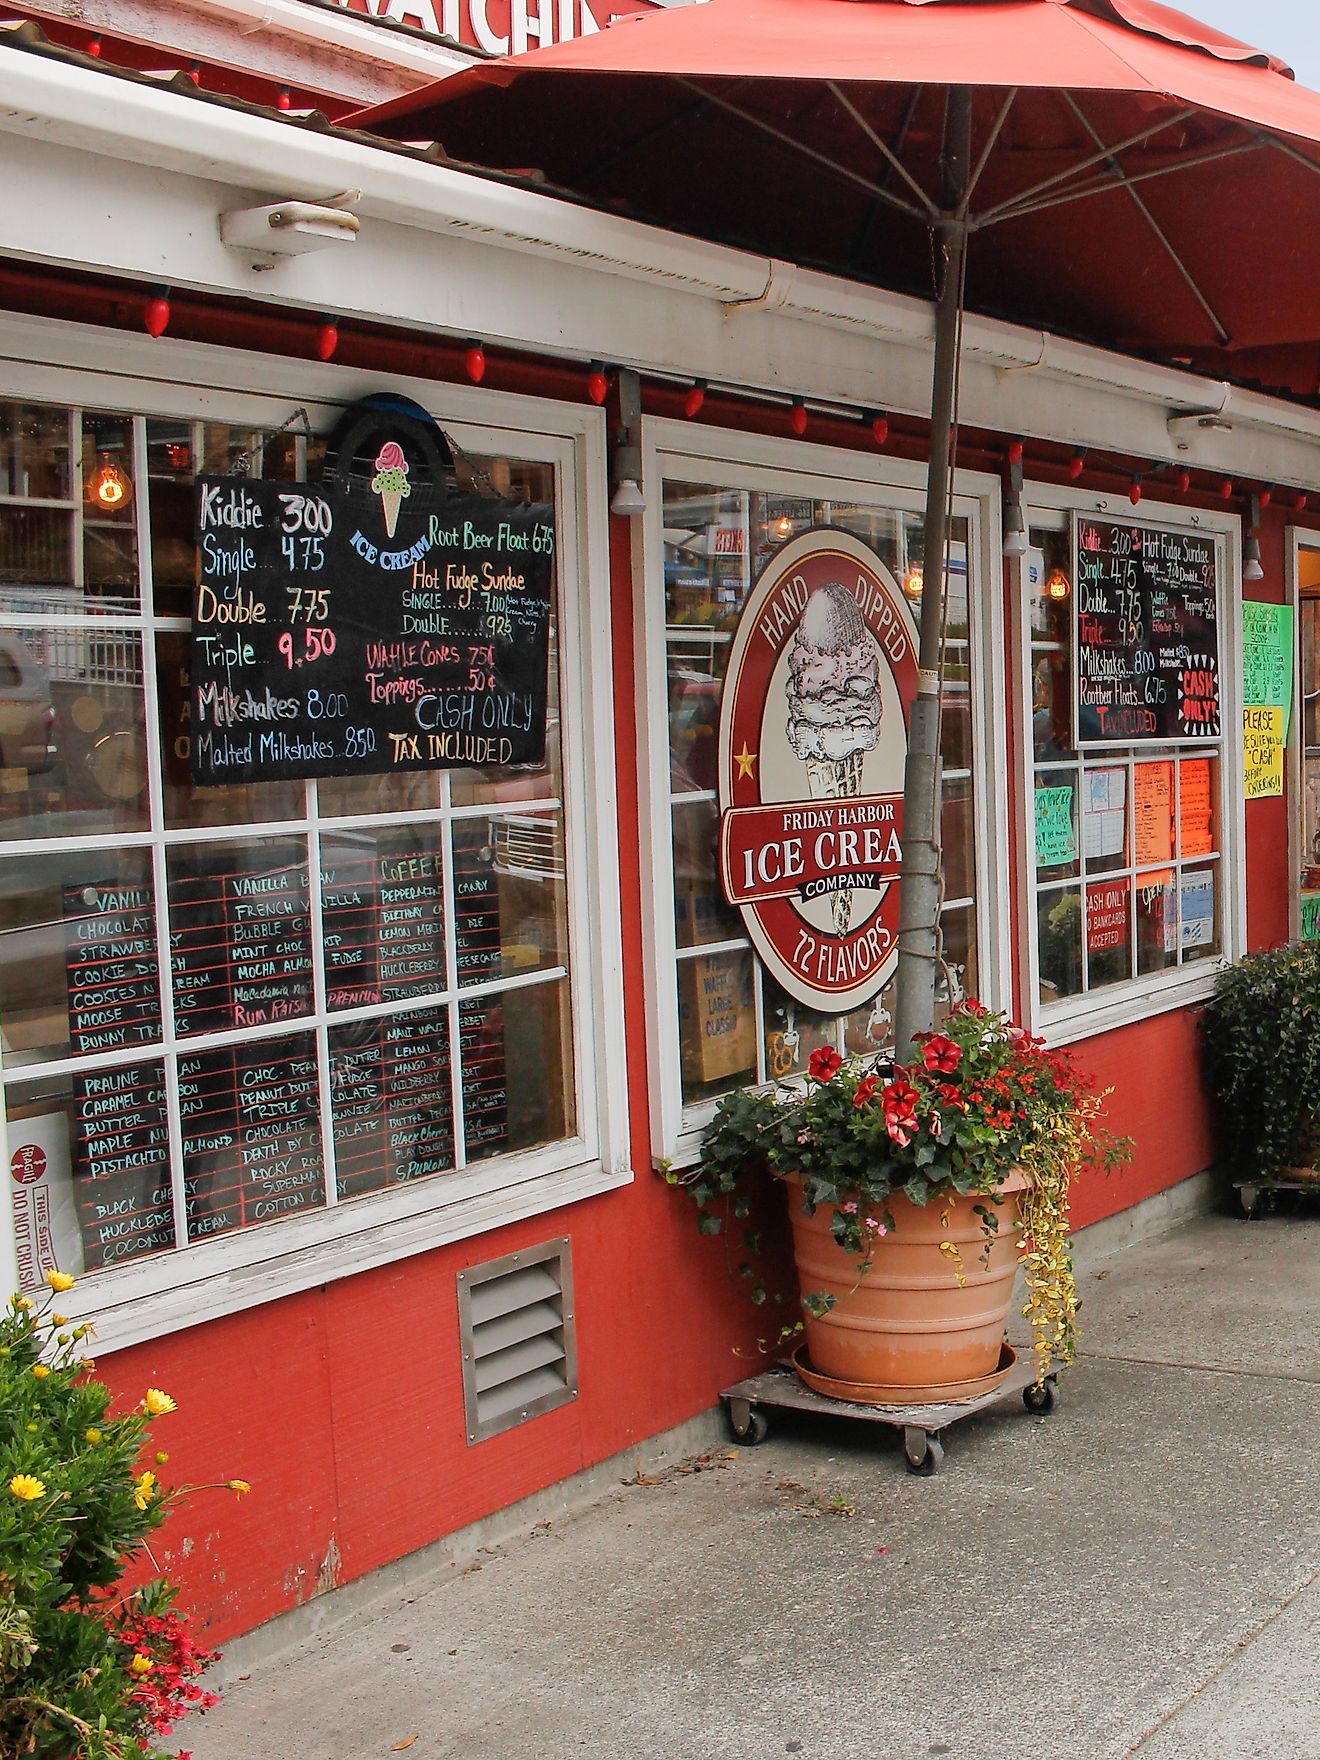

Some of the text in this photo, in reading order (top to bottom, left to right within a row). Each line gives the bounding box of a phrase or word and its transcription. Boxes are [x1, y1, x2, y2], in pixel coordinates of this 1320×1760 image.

[200, 483, 264, 530] Kiddie
[429, 514, 529, 552] Root Beer Float
[1079, 521, 1102, 551] Kiddie
[350, 529, 433, 571] ICE CREAM
[1142, 530, 1209, 563] Hot Fudge Sundae
[203, 533, 256, 600] Single
[1079, 550, 1105, 587] Single
[1110, 558, 1137, 590] 4.75
[1180, 566, 1198, 583] Double
[412, 560, 526, 609] Hot Fudge Sundae
[198, 585, 266, 624] Double
[402, 589, 506, 613] SINGLE 7.00
[1080, 583, 1142, 622] Double 7.75
[1182, 594, 1204, 616] Toppings
[760, 574, 909, 664] HAND DIPPED
[1078, 614, 1104, 649] Triple
[195, 627, 336, 682] Triple 9.50
[1080, 645, 1126, 677] Milkshakes
[1134, 649, 1155, 675] 8.00
[365, 672, 425, 705] Toppings
[1080, 676, 1112, 706] Rootbeer
[1114, 679, 1138, 706] Floats
[1144, 676, 1167, 704] 6.75
[1183, 670, 1214, 699] CASH
[198, 680, 301, 727] Milkshakes
[306, 688, 349, 719] 8.00
[414, 692, 533, 731] CASH ONLY
[1182, 698, 1218, 723] ONLY!
[1243, 709, 1273, 732] PLEASE
[198, 730, 335, 772] Malted Milkshakes
[388, 731, 513, 765] TAX INCLUDED
[783, 803, 895, 832] FRIDAY HARBOR
[743, 827, 903, 889] ICE CREA
[233, 875, 288, 897] VANILLA
[458, 880, 488, 894] CANDY
[805, 873, 875, 897] COMPANY
[235, 901, 294, 921] FRENCH
[1106, 889, 1128, 910] ONLY
[382, 906, 423, 924] BIRTHDAY
[1093, 911, 1127, 932] BANKCARDS
[233, 920, 282, 942] BUBBLE
[380, 927, 410, 942] LEMON
[1090, 930, 1120, 949] ACCEPTED
[232, 944, 268, 960] MINT
[380, 941, 434, 961] BLACKBERRY
[792, 916, 891, 983] 72 FLAVORS
[74, 963, 126, 987] COOKIE
[238, 949, 363, 980] MOCHA FUDGE
[380, 959, 440, 980] HUCKLEBERRY
[73, 985, 137, 1010] COOKIES
[77, 1007, 123, 1029] MOOSE
[80, 1028, 126, 1051] BUNNY
[387, 1026, 414, 1041] MAUI
[344, 1048, 381, 1067] BUTTER
[395, 1044, 431, 1058] LEMON
[394, 1060, 426, 1075] MANGO
[85, 1070, 140, 1097] PRALINE
[240, 1068, 373, 1106] PEANUT FUDGE
[82, 1093, 141, 1117] CARAMEL
[243, 1099, 300, 1123] TRIPLE
[84, 1113, 146, 1137] BUTTER
[245, 1117, 309, 1144] CHOCOLATE
[389, 1113, 425, 1129] BUTTER
[88, 1133, 134, 1158] MAPLE
[90, 1135, 233, 1179] PISTACHIO ALMOND
[241, 1136, 302, 1164] DEATH BY
[395, 1147, 417, 1159] PLAY
[20, 1147, 37, 1184] FRAGILE
[251, 1156, 292, 1182] ROCKY
[96, 1197, 137, 1219] BLACK
[255, 1191, 305, 1219] COTTON
[36, 1194, 50, 1256] THIS SIDE
[189, 1213, 233, 1237] CREAM
[12, 1189, 36, 1292] DO NOT CRUSH
